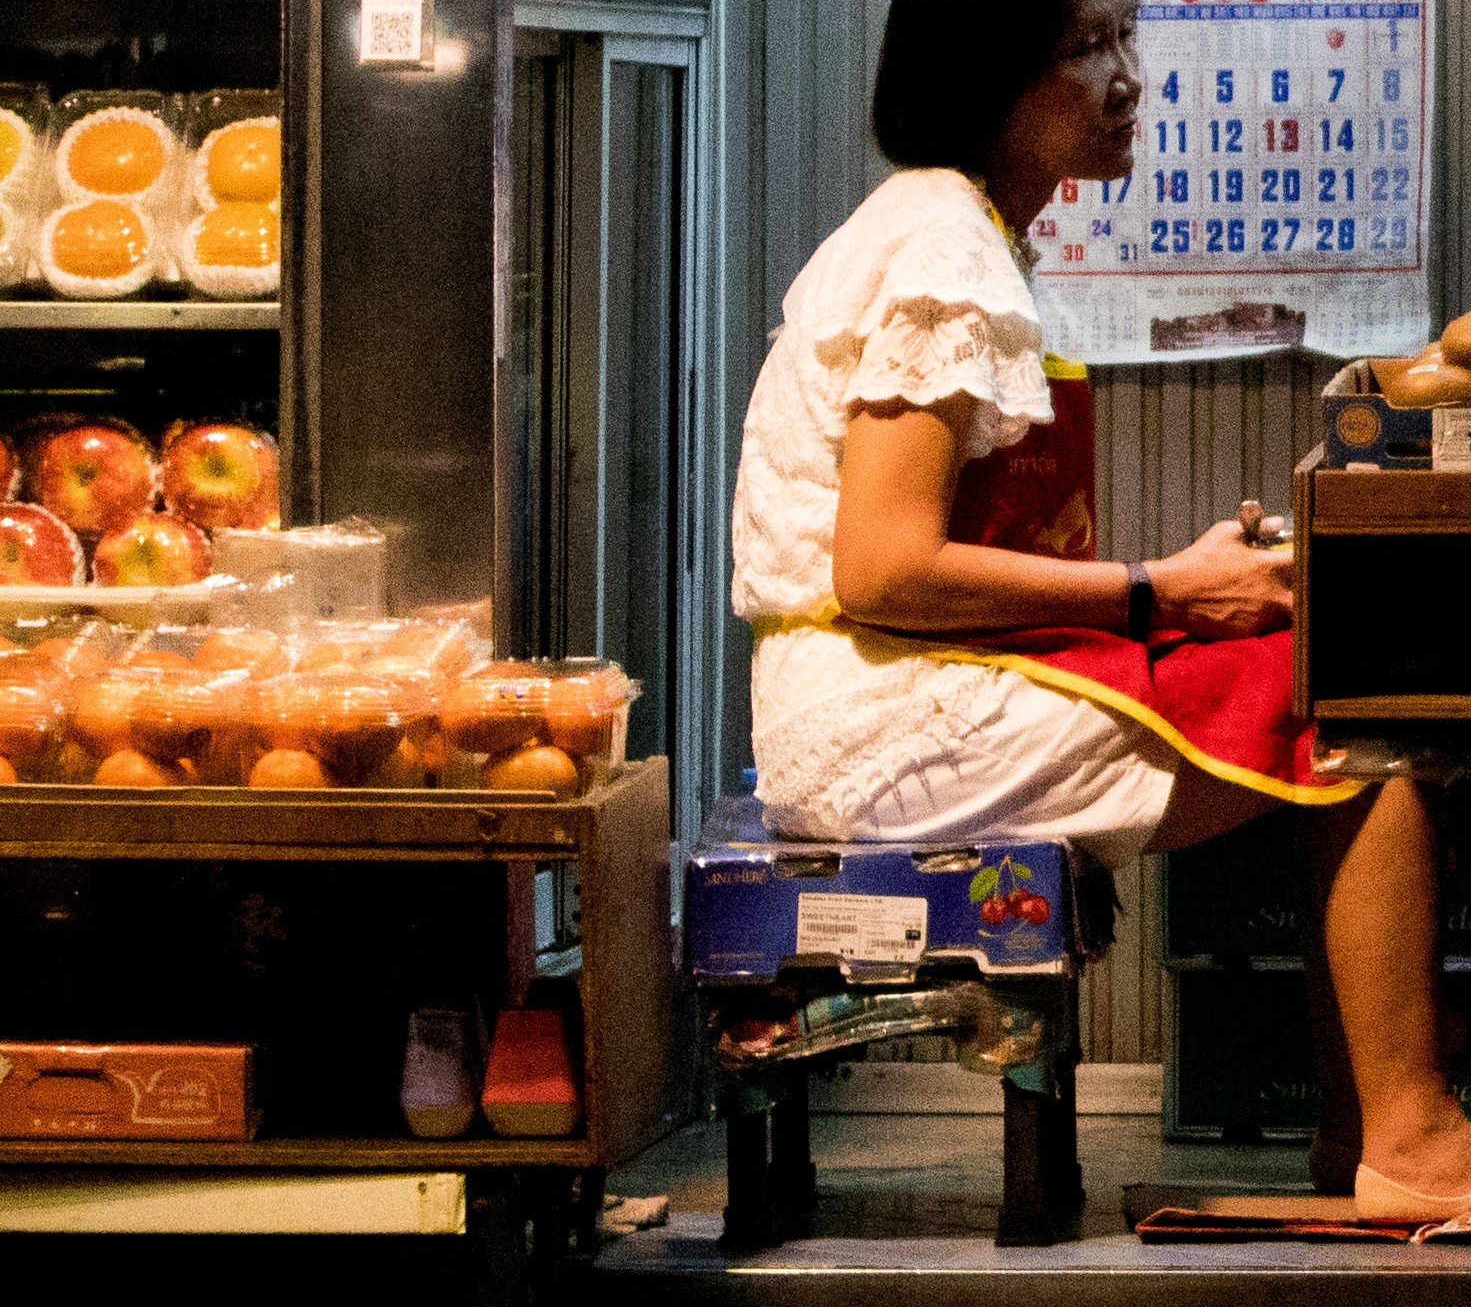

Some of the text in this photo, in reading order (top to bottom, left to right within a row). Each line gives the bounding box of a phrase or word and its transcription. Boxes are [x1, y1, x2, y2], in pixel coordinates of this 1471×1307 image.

[1162, 71, 1180, 103] 4
[1215, 70, 1235, 103] 5
[1271, 70, 1290, 103] 6
[1327, 70, 1346, 102] 7
[1156, 119, 1410, 154] 11 12 13 14 15
[1156, 169, 1189, 203] 18
[1209, 169, 1244, 204] 19
[1262, 169, 1301, 203] 20
[1319, 168, 1356, 202] 21
[1371, 168, 1411, 202] 22
[1091, 217, 1112, 238] 24
[1151, 219, 1191, 253] 25
[1206, 219, 1246, 253] 26
[1261, 219, 1301, 253] 27
[1317, 219, 1356, 252] 28
[1371, 218, 1408, 251] 29
[1062, 244, 1139, 263] 30 31
